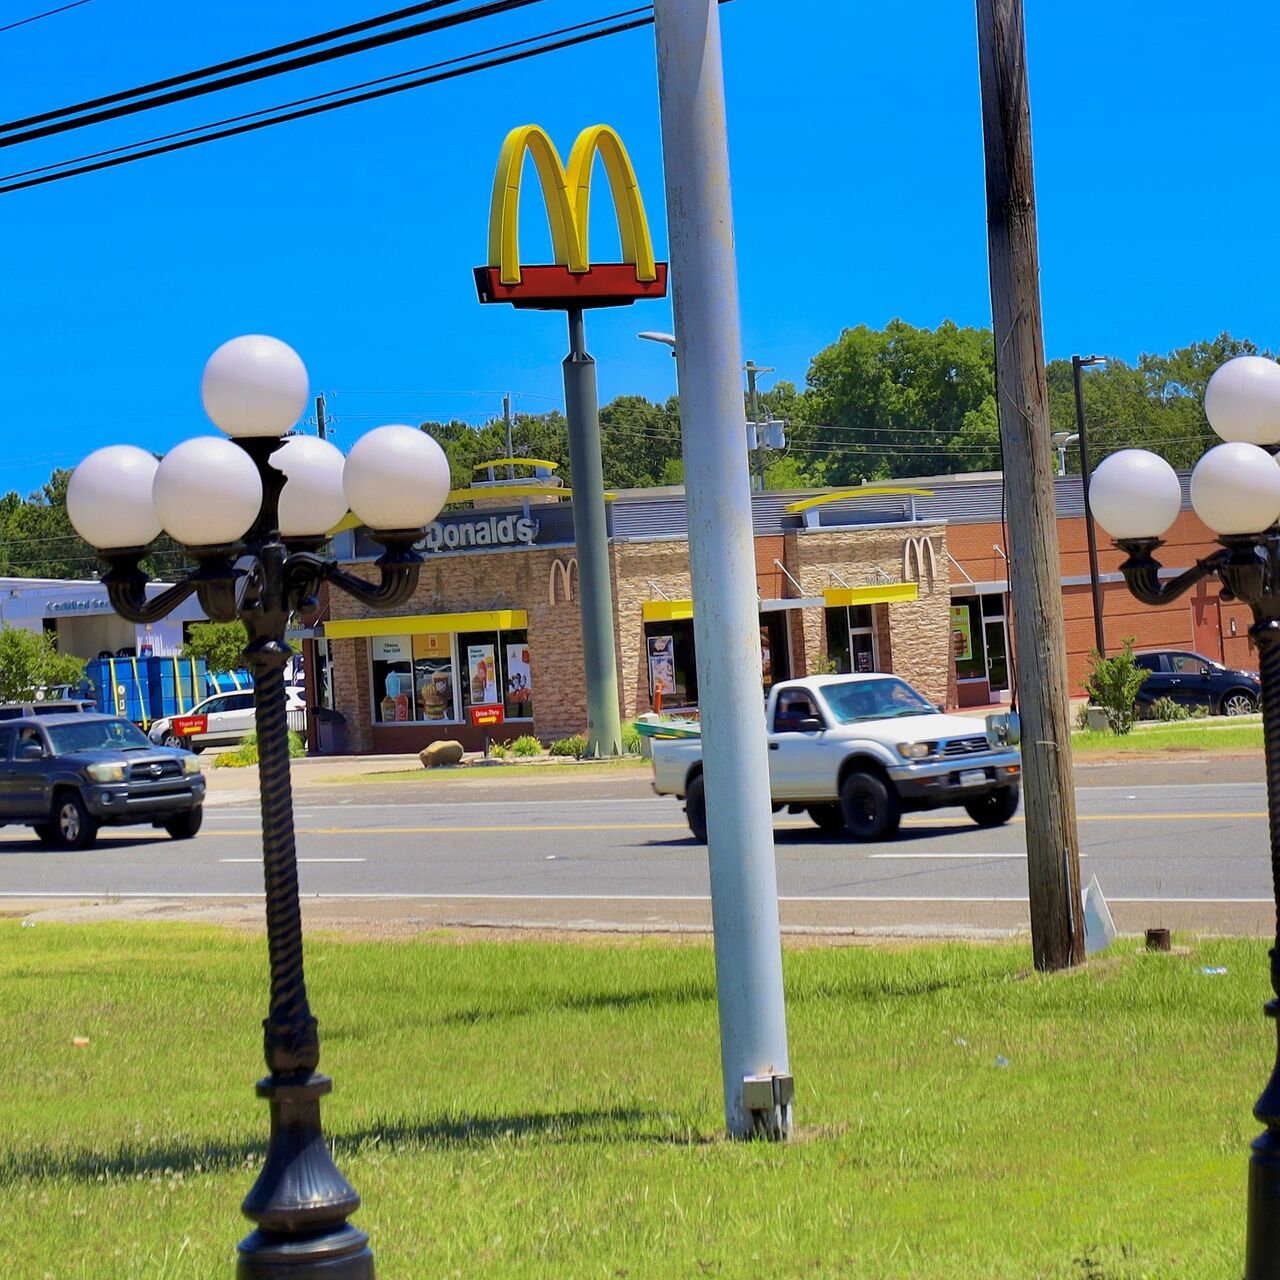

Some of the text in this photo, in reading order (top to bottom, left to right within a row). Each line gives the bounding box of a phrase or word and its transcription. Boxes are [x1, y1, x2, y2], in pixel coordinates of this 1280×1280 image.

[412, 515, 534, 550] cDonald's
[46, 598, 109, 612] Certified Ser
[179, 720, 194, 728] Thank
